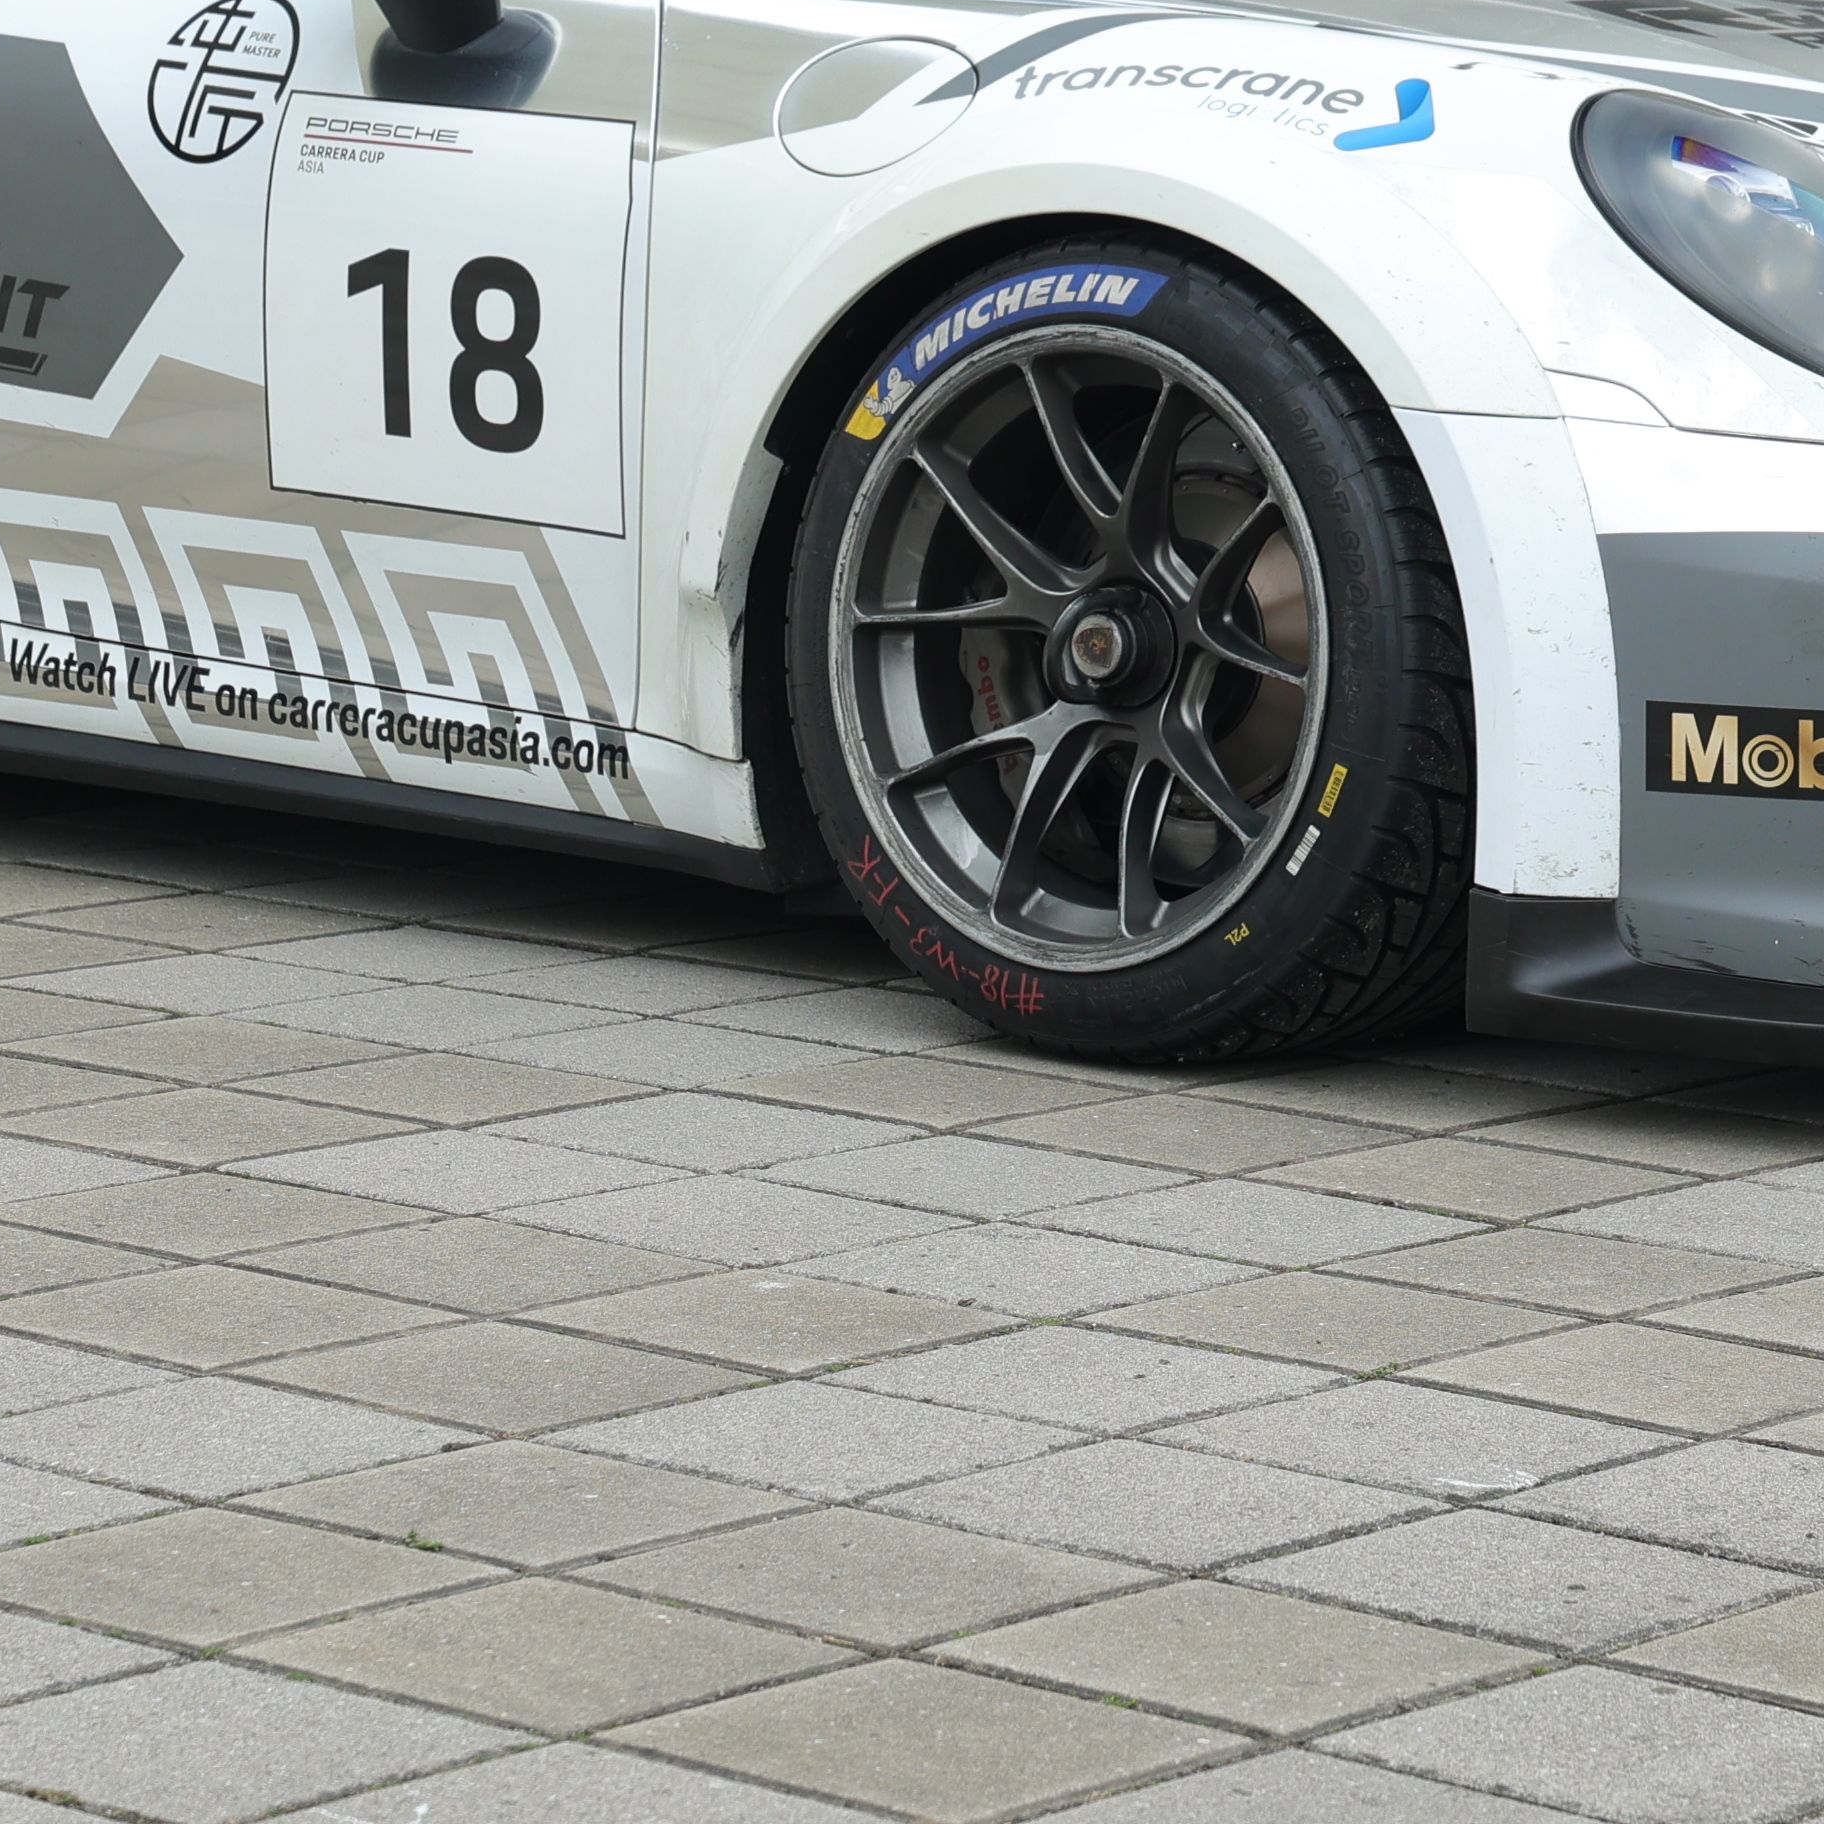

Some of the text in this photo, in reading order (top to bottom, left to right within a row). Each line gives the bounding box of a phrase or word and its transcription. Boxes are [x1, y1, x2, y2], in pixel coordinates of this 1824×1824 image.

[248, 31, 277, 43] PURE
[242, 45, 281, 59] MASTER
[1014, 64, 1365, 114] transcrane
[305, 117, 460, 143] PORSCHE
[300, 144, 385, 164] CARRERA CUP
[297, 160, 325, 174] ASIA
[914, 272, 1140, 371] MICHELIN
[347, 247, 544, 453] 18
[9, 637, 630, 780] Watch LIVE on carreracupasia.com
[1224, 922, 1251, 946] P2L
